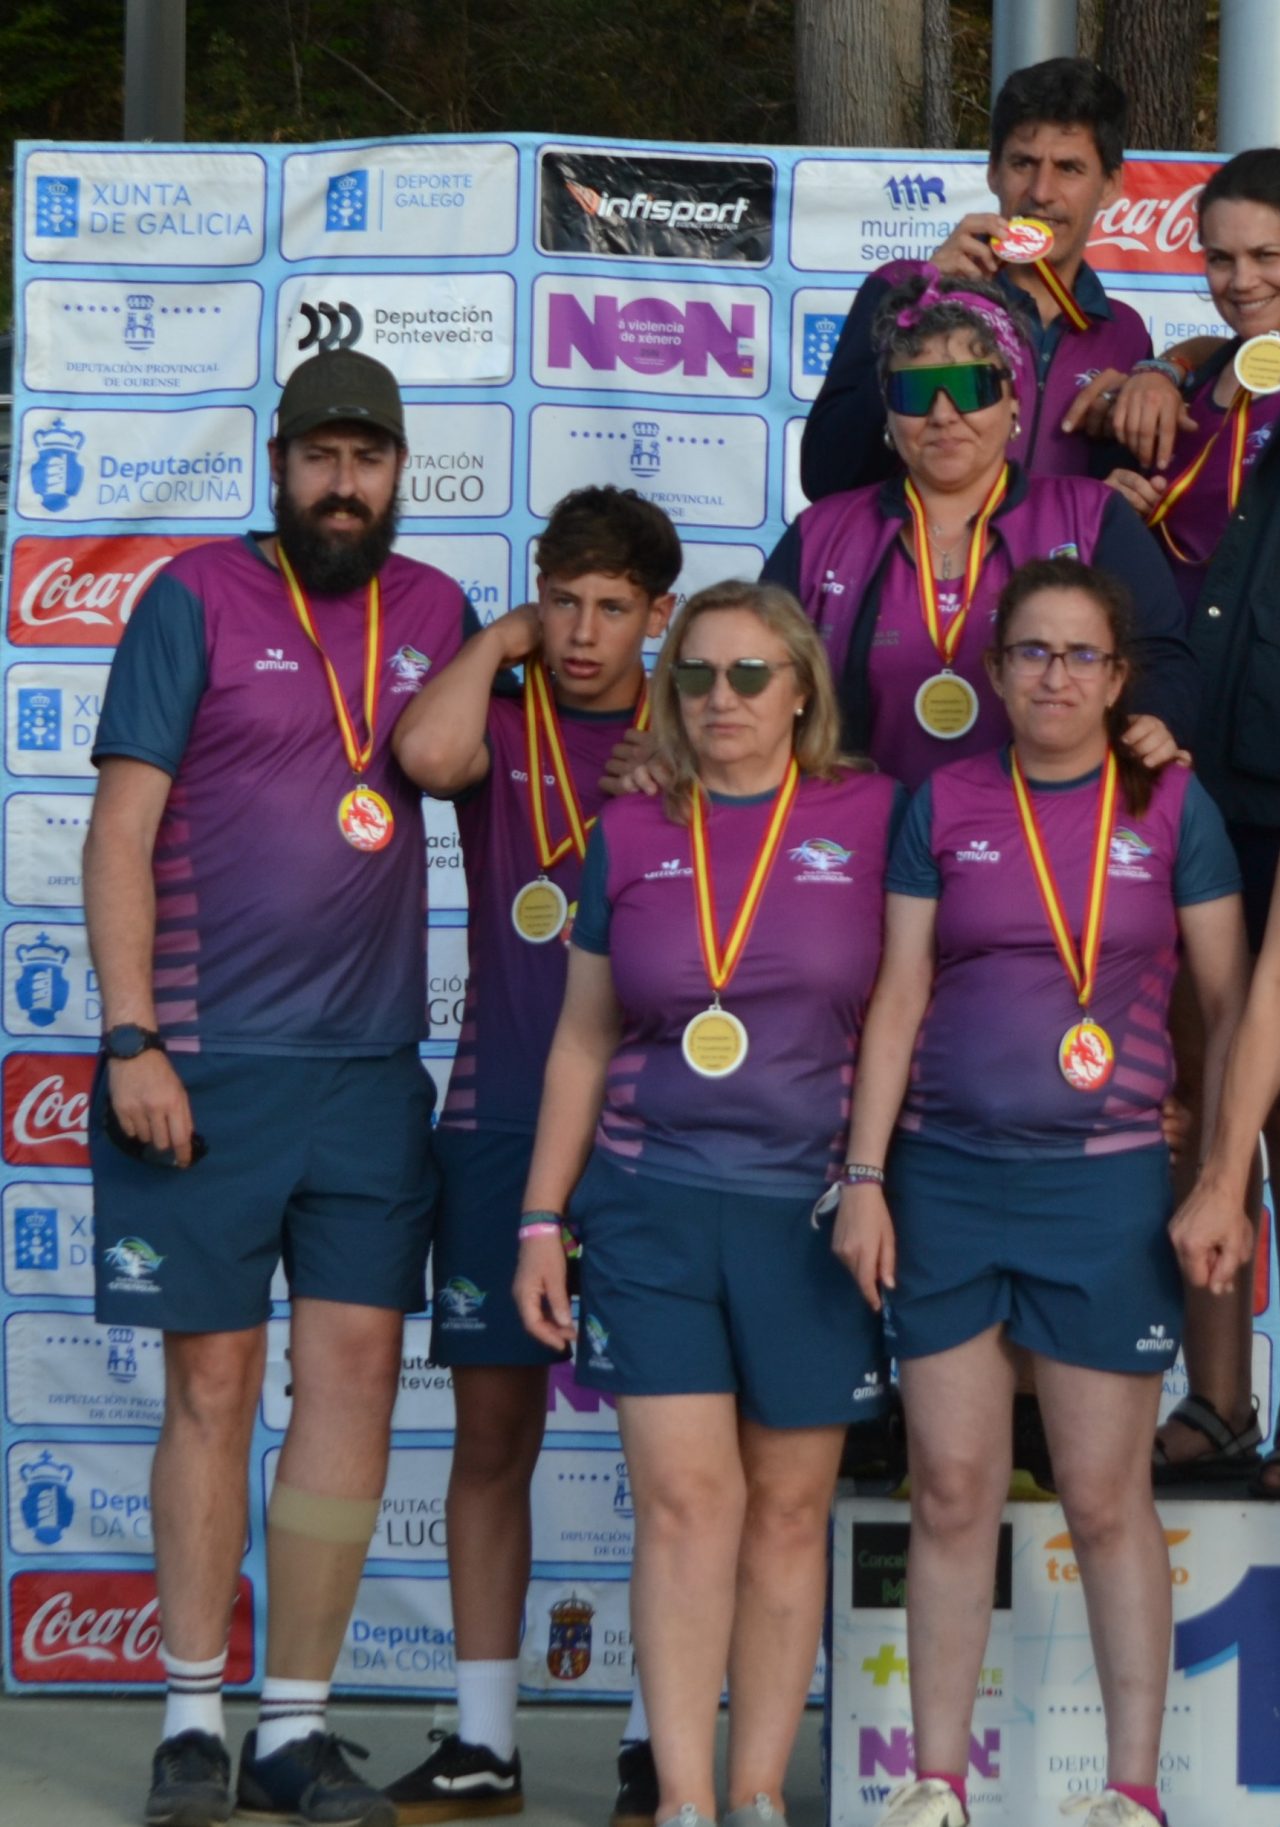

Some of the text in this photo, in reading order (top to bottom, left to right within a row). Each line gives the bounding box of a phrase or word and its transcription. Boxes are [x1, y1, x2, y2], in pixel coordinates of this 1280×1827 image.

[396, 174, 472, 189] DEPORTE
[92, 183, 191, 206] XUNTA
[395, 193, 464, 208] GALEGO
[597, 192, 749, 228] infisport
[90, 213, 252, 236] DE GALICIA
[375, 308, 493, 328] Deputación
[628, 319, 684, 334] violencia
[1165, 322, 1231, 338] DEPORT
[375, 325, 493, 345] Pontevedra
[621, 331, 681, 346] de xénero
[137, 360, 220, 374] PROVINCIAL
[104, 377, 181, 388] DE OURENSE
[100, 451, 243, 482] Deputación
[99, 474, 242, 505] DA CORUÑA
[651, 491, 724, 506] PROVINCIAL
[20, 557, 174, 627] Coca-C
[255, 658, 299, 671] amura
[956, 849, 999, 863] amura
[1136, 1338, 1174, 1352] amura
[90, 1516, 126, 1538] DA
[22, 1592, 164, 1663] Coca-C
[352, 1649, 387, 1670] DA
[603, 1651, 626, 1666] DE
[1049, 1755, 1191, 1772] DEPUÓN
